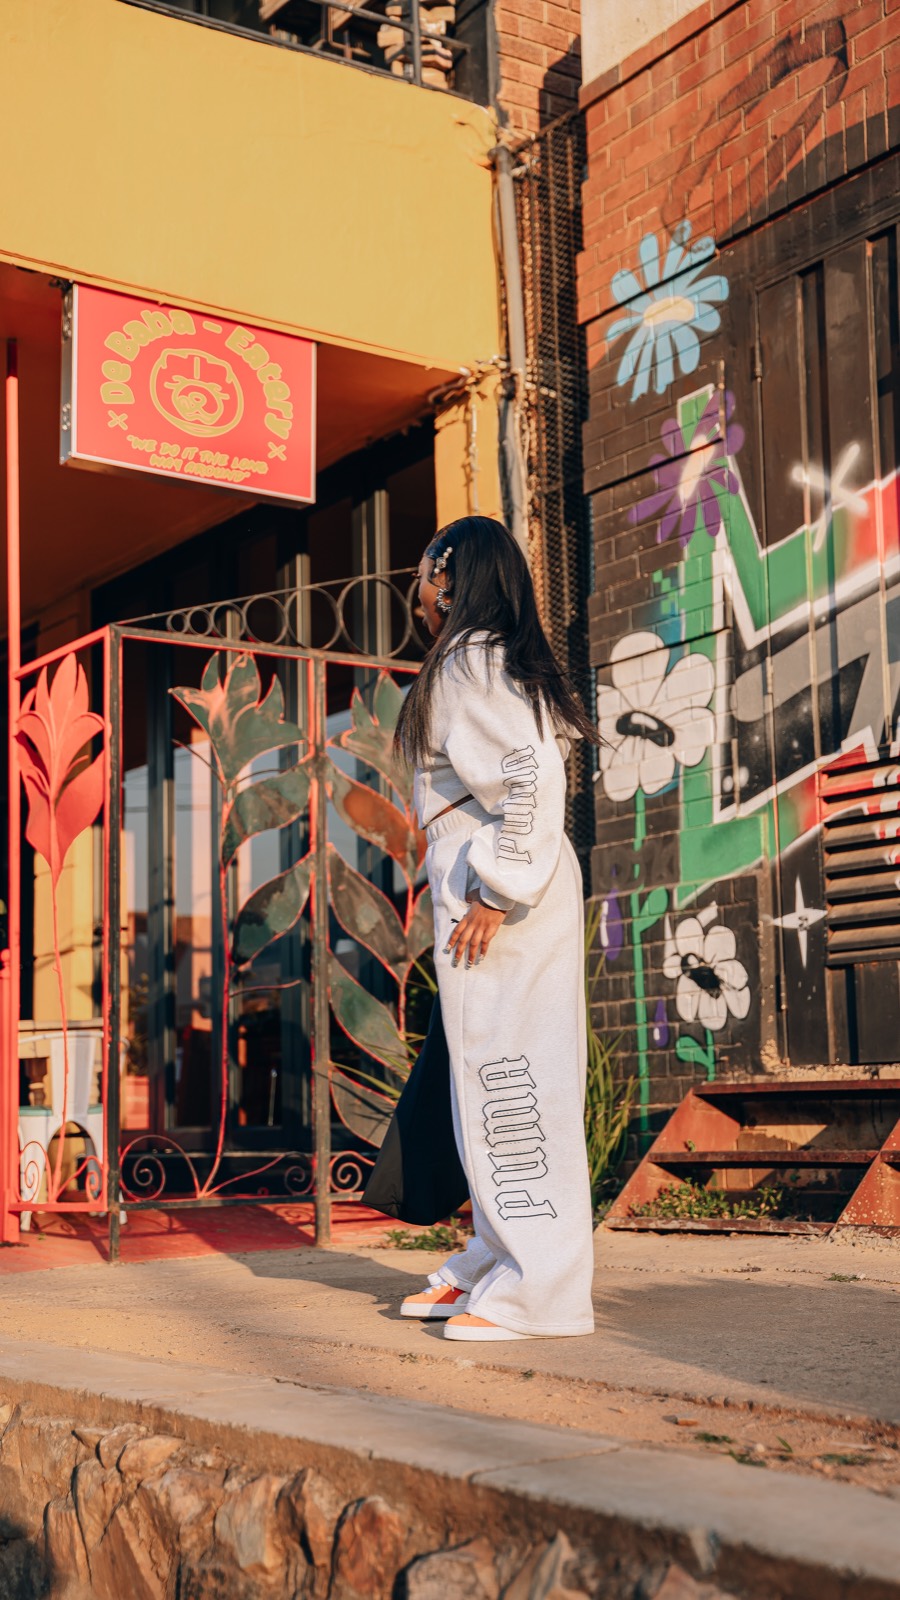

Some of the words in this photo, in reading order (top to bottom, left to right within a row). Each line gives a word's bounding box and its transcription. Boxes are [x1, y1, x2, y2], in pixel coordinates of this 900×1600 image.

[104, 310, 196, 361] Baba
[100, 360, 135, 404] De
[224, 325, 294, 440] Eatery
[149, 453, 183, 472] WAY
[159, 442, 181, 457] DO
[181, 447, 199, 460] IT
[199, 450, 229, 466] THE
[231, 456, 269, 475] LONG
